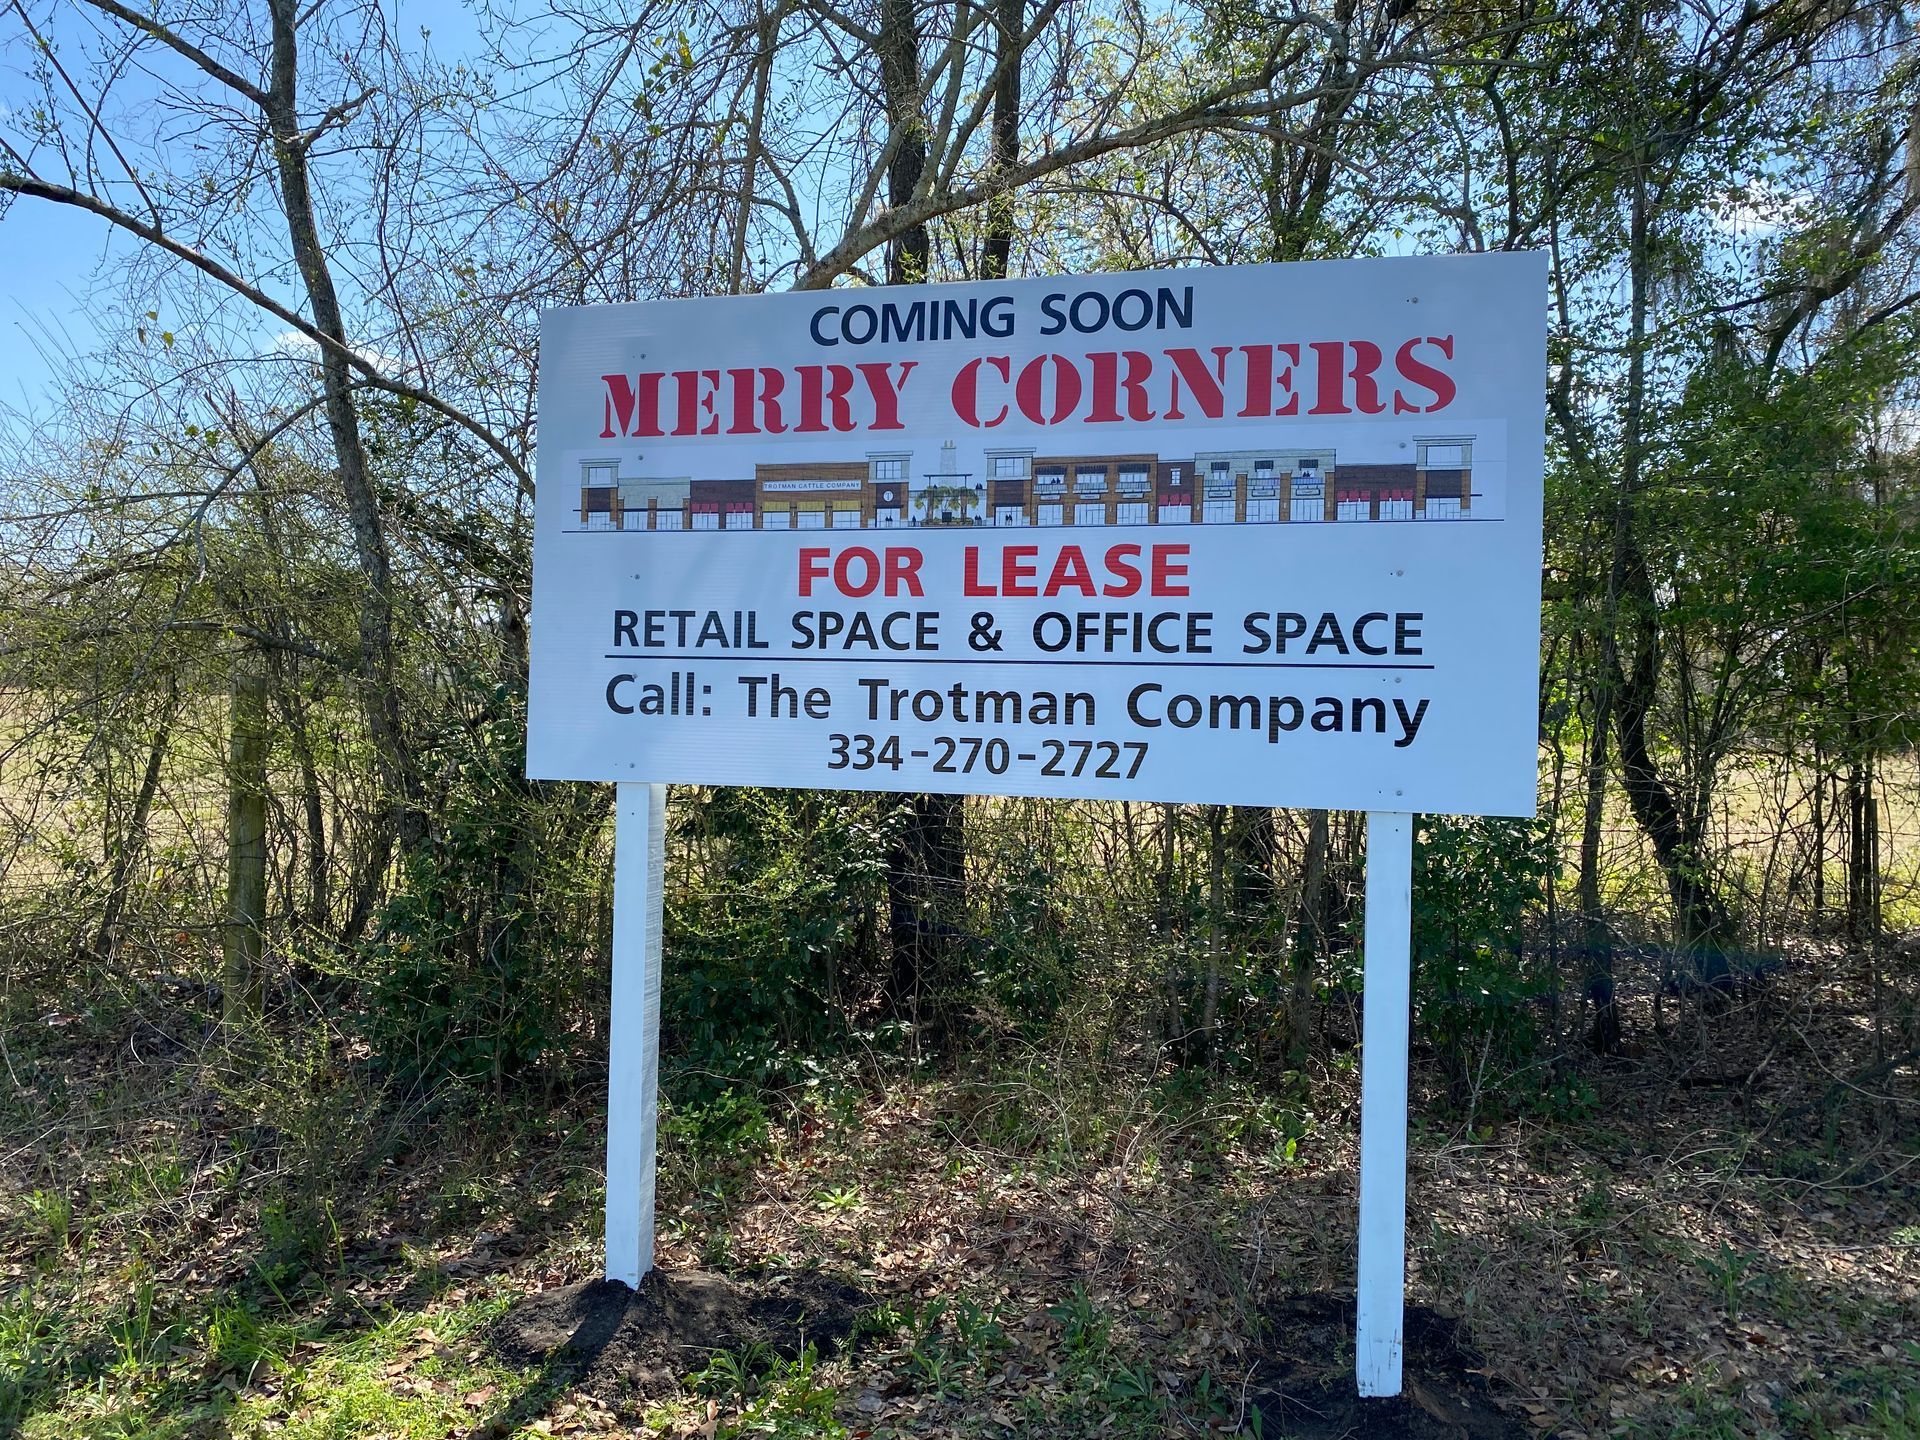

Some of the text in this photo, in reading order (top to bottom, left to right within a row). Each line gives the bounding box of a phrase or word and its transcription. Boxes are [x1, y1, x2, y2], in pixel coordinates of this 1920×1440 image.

[810, 286, 1195, 347] COMING SOON
[599, 334, 1457, 439] MERRY CORNERS
[764, 482, 796, 490] TROTMAN
[826, 481, 860, 489] COMPANY
[798, 543, 1190, 598] FOR LEASE
[613, 609, 1424, 656] RETAIL SPACE & OFFICE SPACE
[605, 671, 1431, 748] Call: The Trotman Company
[827, 733, 1150, 780] 334-270-2727
